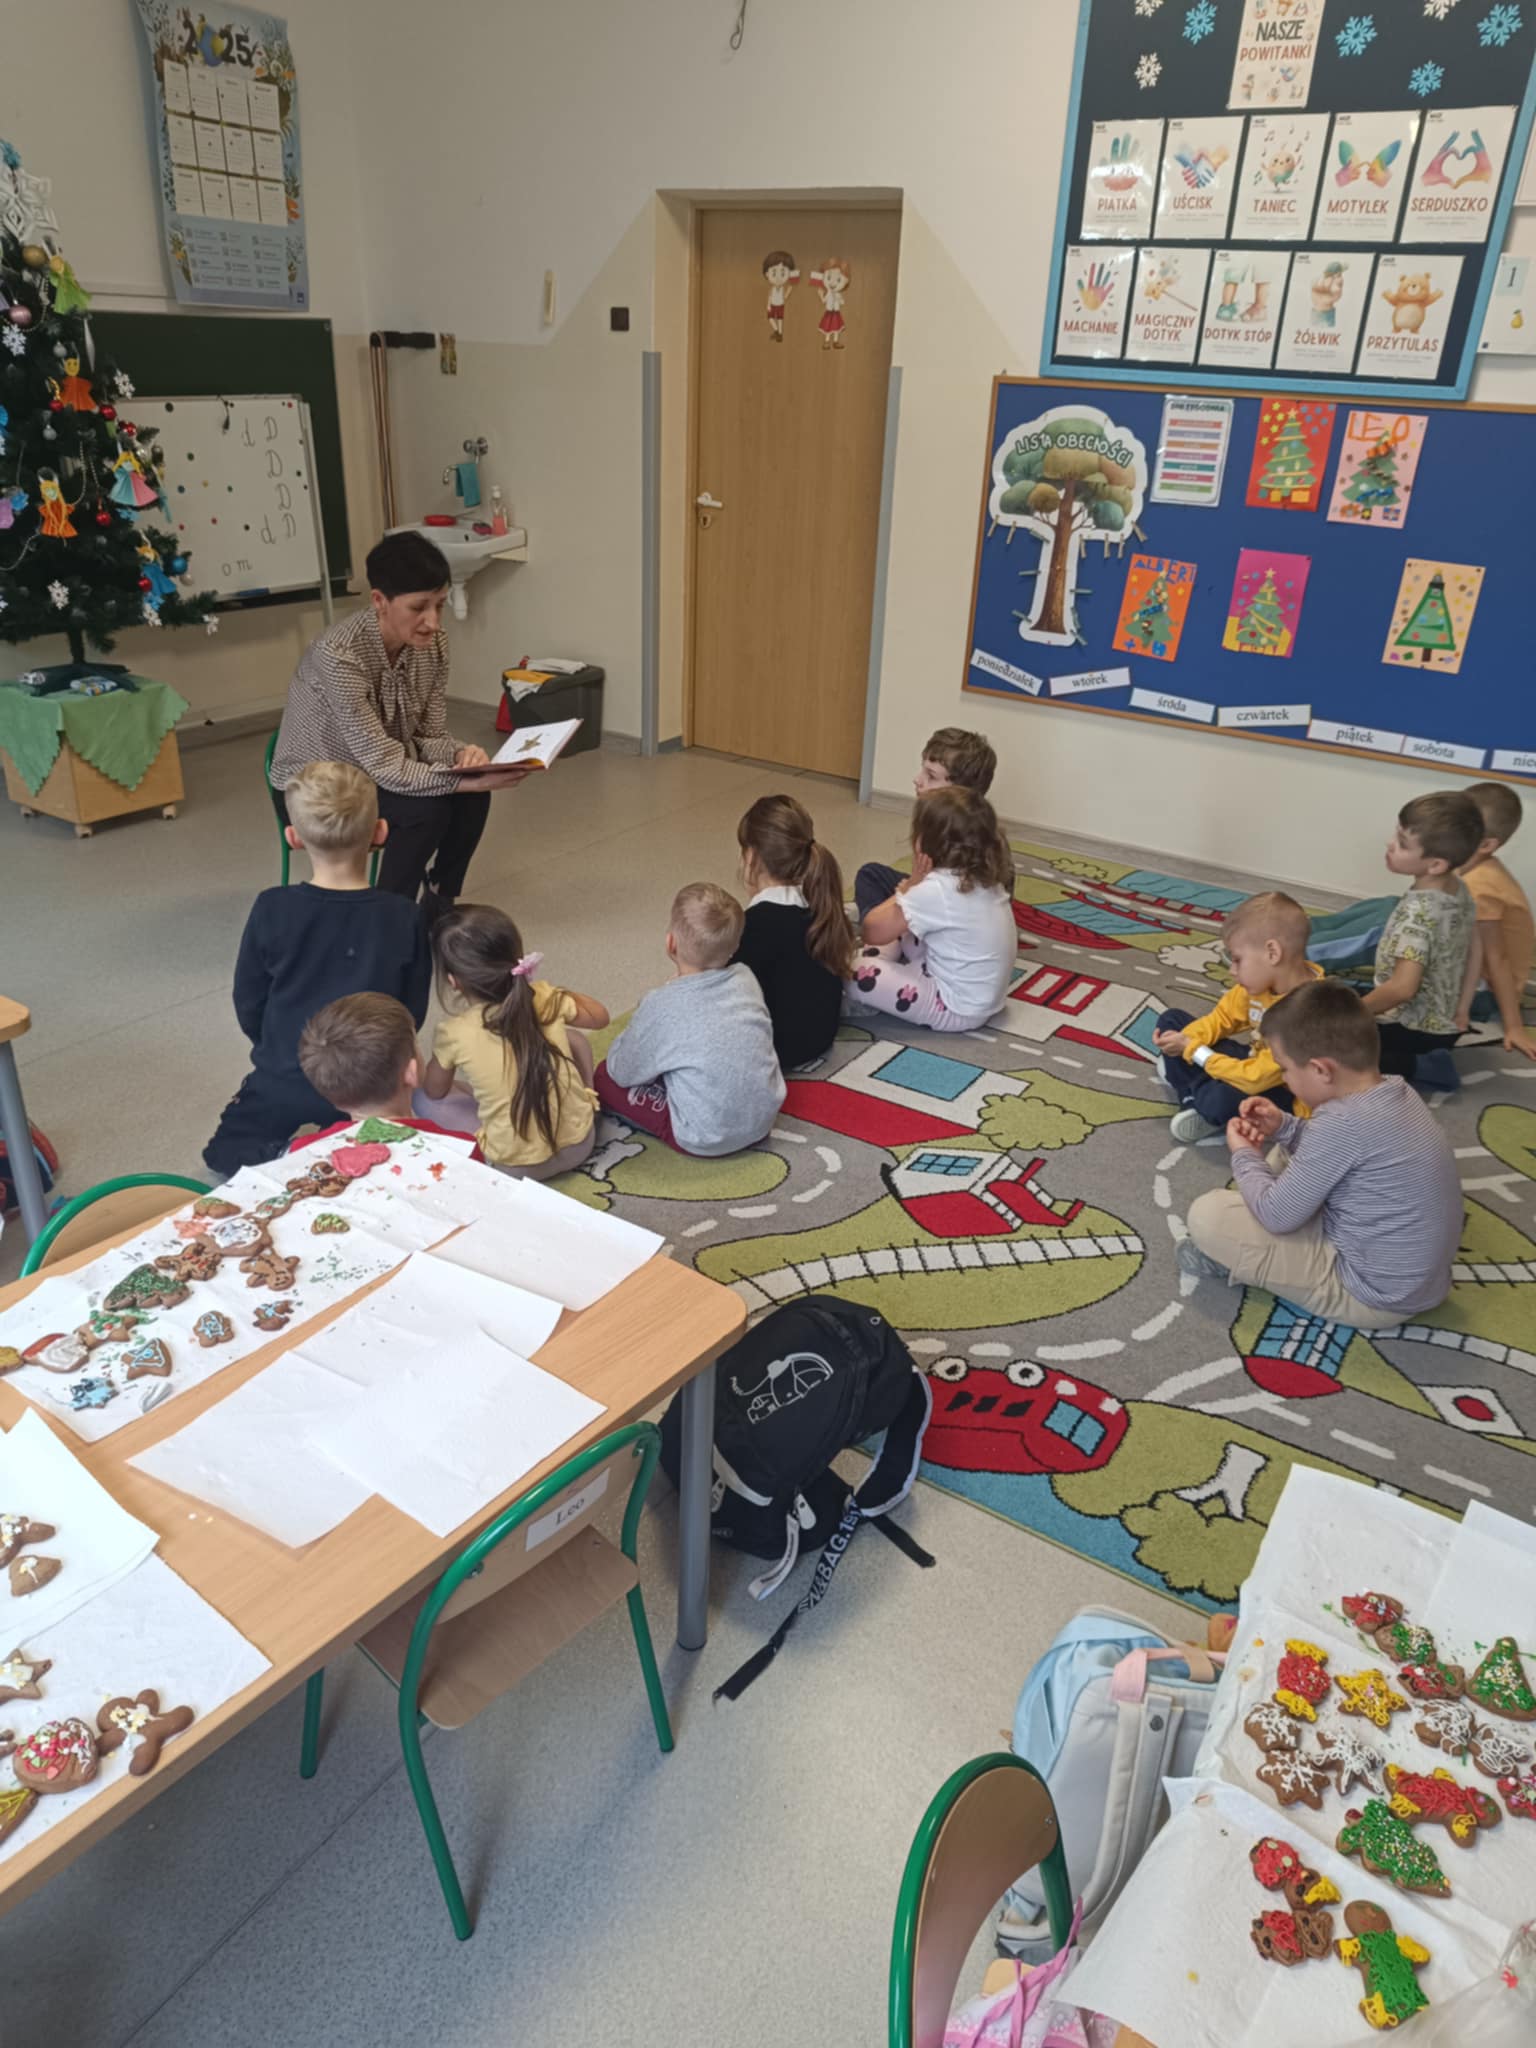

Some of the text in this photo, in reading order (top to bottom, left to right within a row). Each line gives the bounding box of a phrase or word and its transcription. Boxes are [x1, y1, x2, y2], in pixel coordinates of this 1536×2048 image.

[1256, 19, 1305, 42] NASZE
[1240, 43, 1312, 61] POWITANKI
[1173, 193, 1214, 210] UŚCISK
[1253, 199, 1296, 213] TANIEC
[1327, 199, 1389, 214] MOTYLEK
[1410, 197, 1489, 213] SERDUSZKO
[1063, 319, 1118, 335] MACHANIE
[1135, 313, 1195, 329] MAGICZNY
[1143, 328, 1182, 342] DOTYK
[1204, 327, 1273, 344] DOTYK STÓP
[1366, 335, 1439, 353] PRZYTULAS
[1347, 412, 1410, 442] LEO
[1016, 433, 1134, 466] LISTA OBECNOŚCI
[1072, 673, 1108, 688] wtorek
[1156, 696, 1187, 713] środa
[1236, 708, 1290, 721] czwartek
[1336, 728, 1375, 744] piątek
[1413, 741, 1456, 759] sobota
[556, 1498, 585, 1526] Leo
